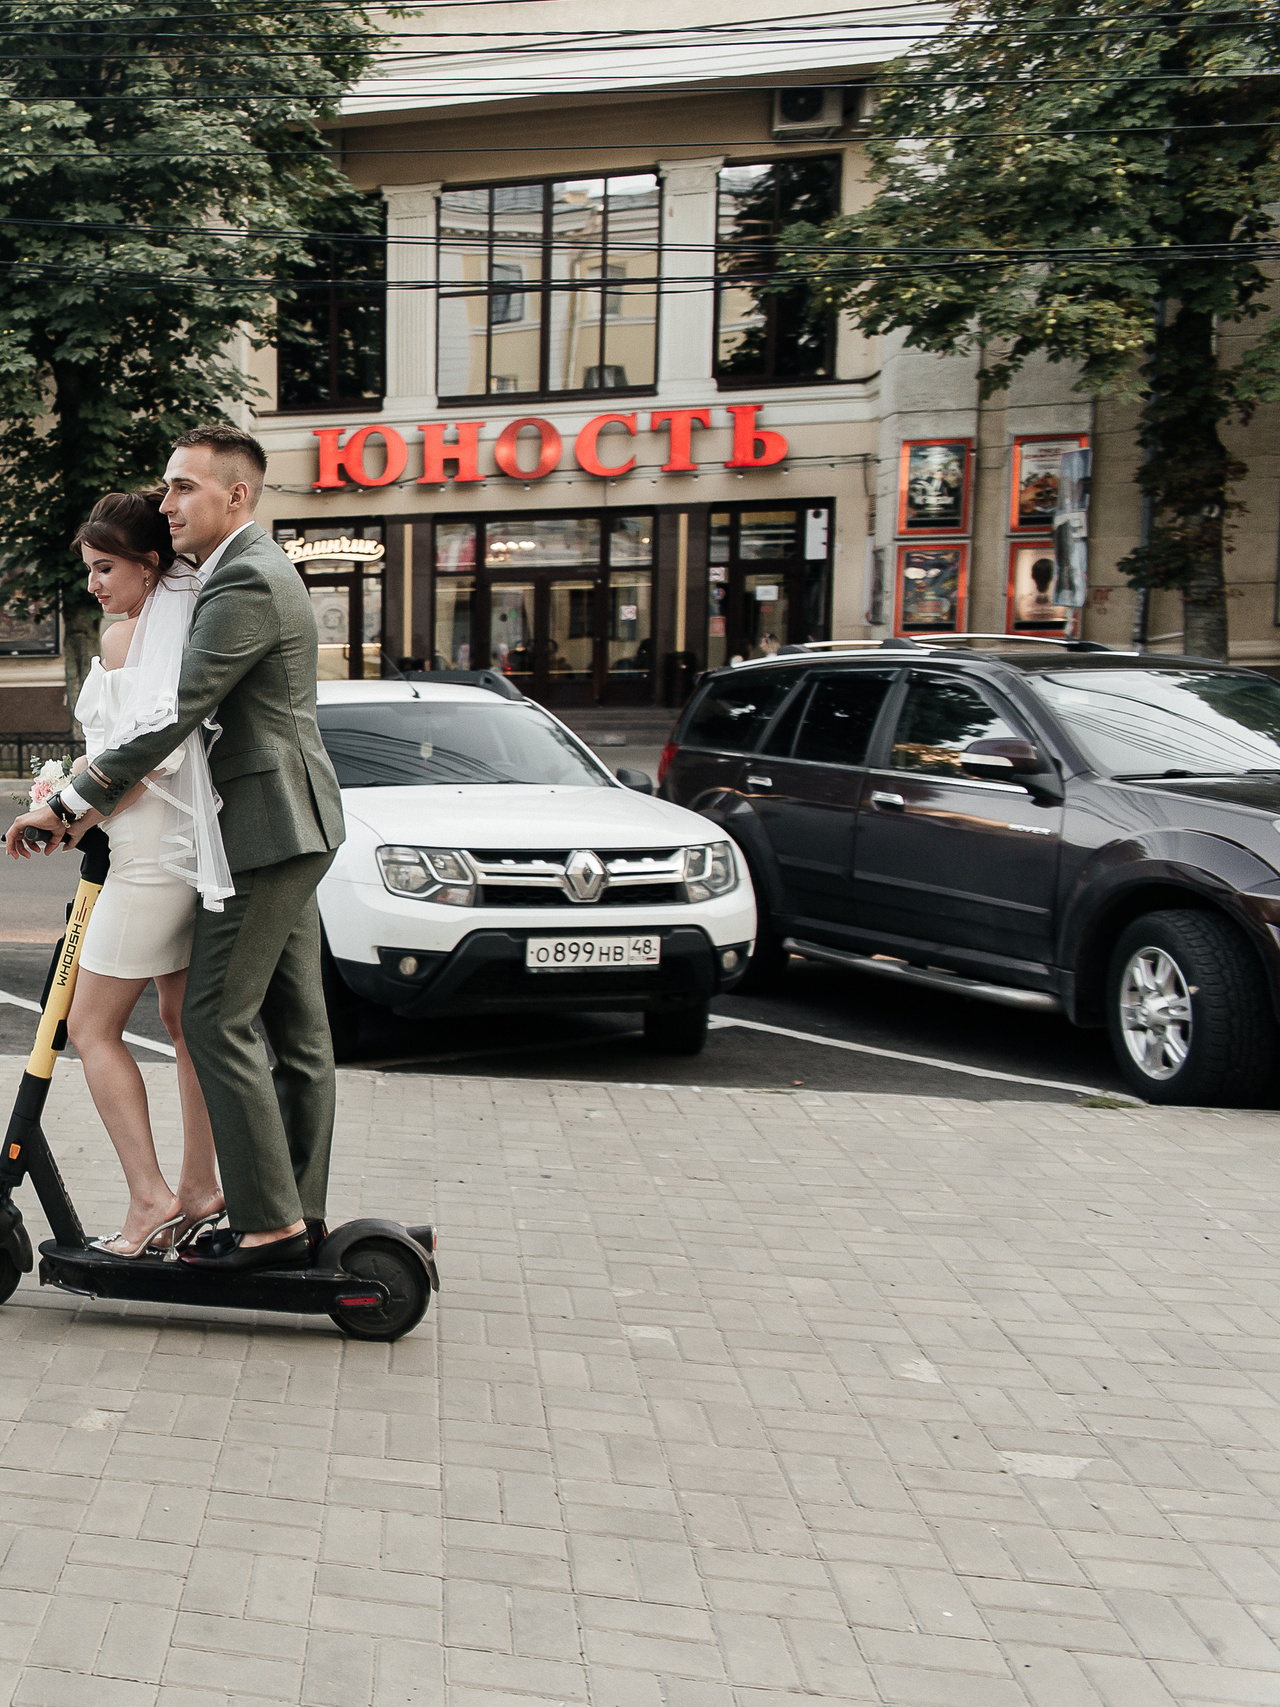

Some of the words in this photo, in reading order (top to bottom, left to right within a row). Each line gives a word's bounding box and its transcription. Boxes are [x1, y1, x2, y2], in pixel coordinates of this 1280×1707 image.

[312, 404, 789, 489] ЮНОСТЬ
[283, 536, 384, 561] Блинчик
[57, 923, 82, 987] WHOOSH
[632, 939, 652, 955] 48
